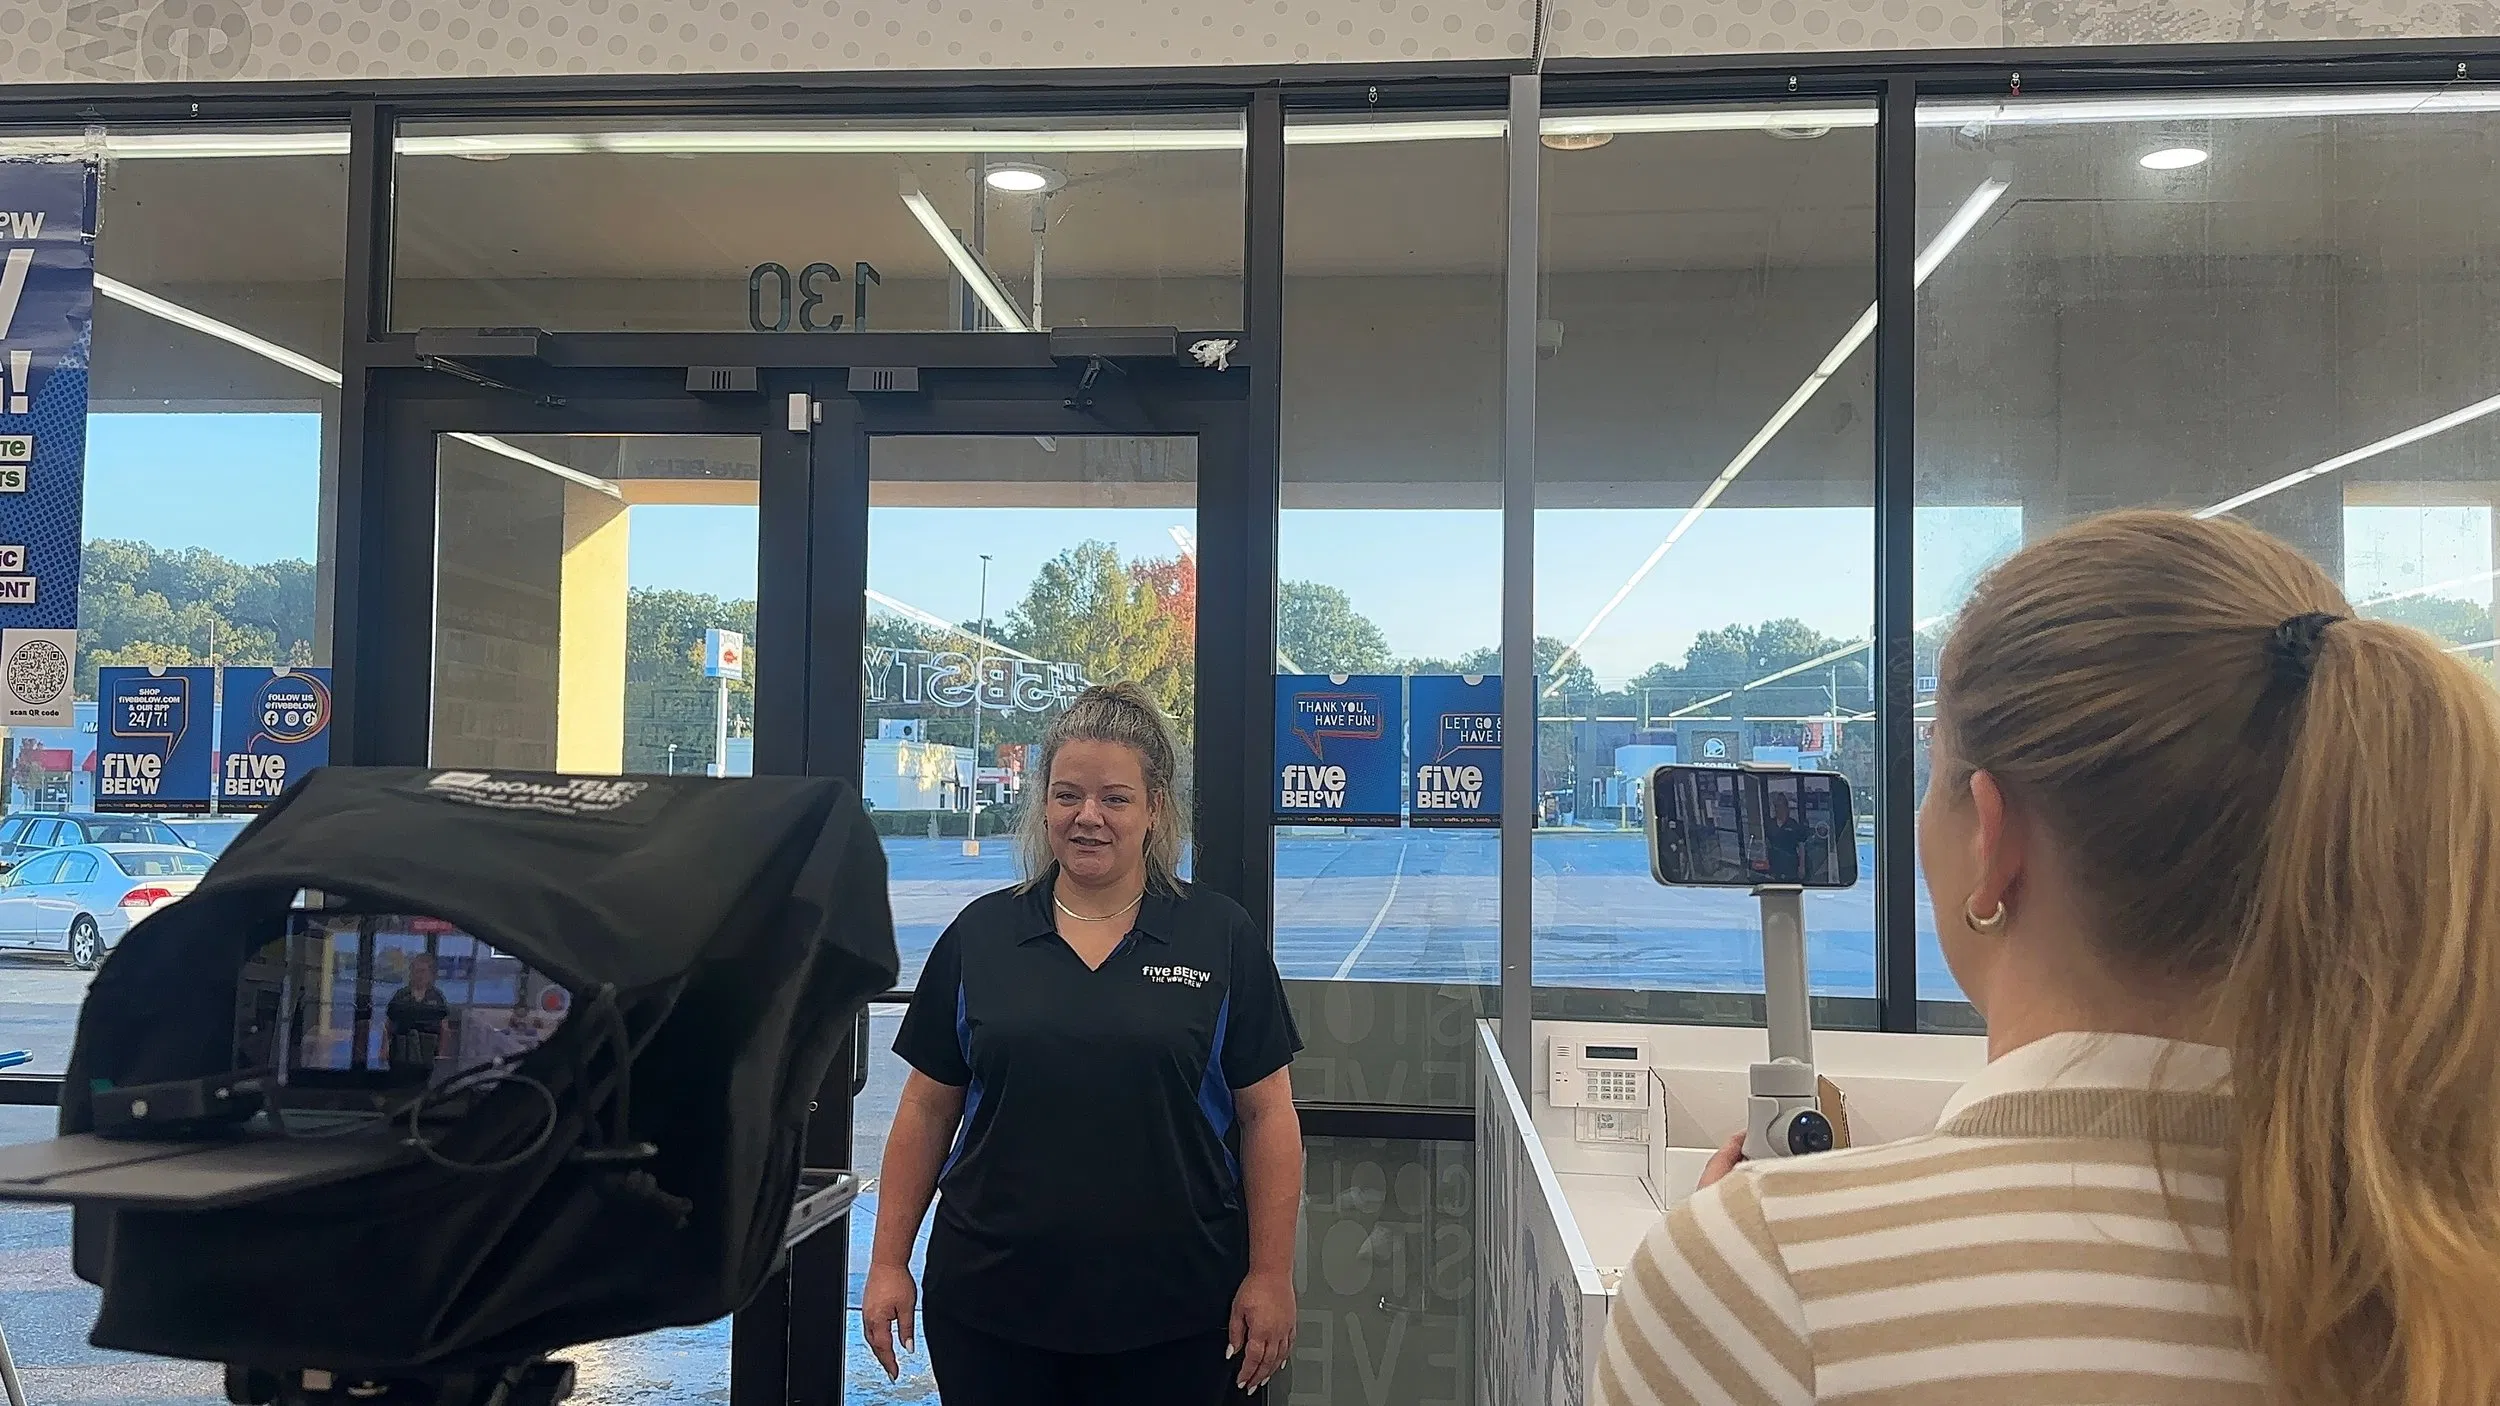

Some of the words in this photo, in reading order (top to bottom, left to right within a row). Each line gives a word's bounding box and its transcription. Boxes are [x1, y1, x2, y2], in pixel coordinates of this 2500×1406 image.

[139, 688, 160, 696] SHOP
[10, 709, 27, 717] scan
[28, 709, 40, 717] QR
[41, 709, 60, 717] code
[1298, 701, 1338, 713] THANK
[1341, 702, 1368, 715] YOU,
[128, 711, 168, 729] 24/7!
[1315, 714, 1345, 726] HAVE
[1348, 715, 1376, 727] FUN!
[1445, 717, 1471, 729] LET
[1475, 717, 1493, 729] GO
[1460, 731, 1494, 742] HAVE
[102, 753, 162, 778] five
[225, 754, 286, 779] five
[1281, 765, 1347, 791] five
[1417, 765, 1483, 792] five
[1142, 966, 1172, 976] five
[1183, 978, 1202, 989] CREW
